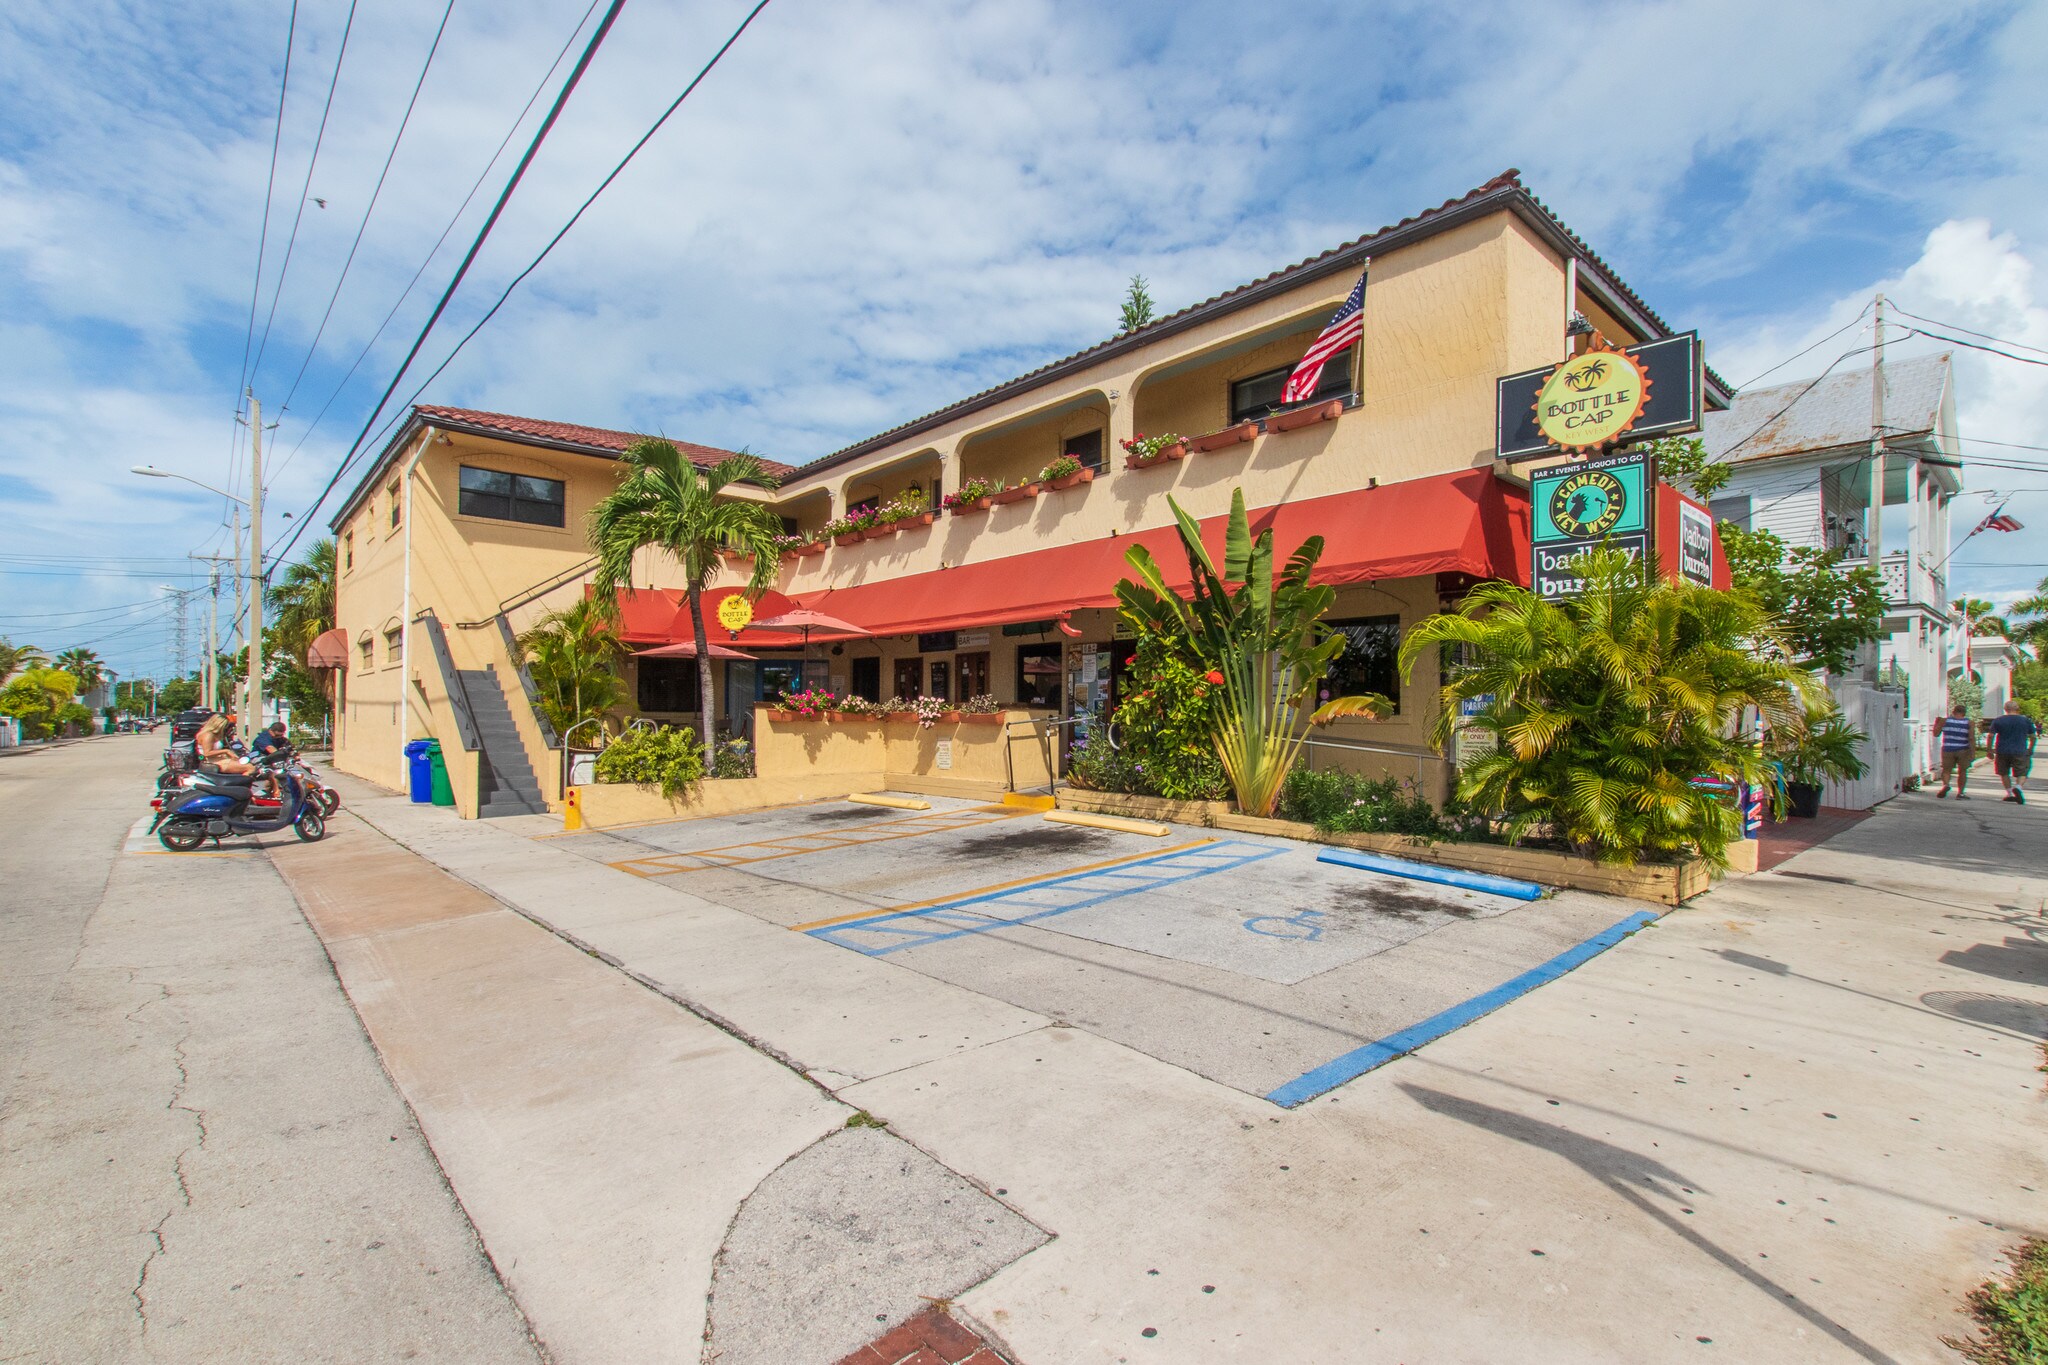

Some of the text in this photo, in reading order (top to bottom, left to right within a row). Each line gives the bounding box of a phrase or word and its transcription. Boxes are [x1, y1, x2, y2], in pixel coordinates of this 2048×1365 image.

[1547, 389, 1630, 418] BOTTLE
[1565, 409, 1613, 429] CAP
[1565, 425, 1610, 439] KEY WEST
[1555, 465, 1581, 475] EVENTS
[1588, 459, 1616, 469] LIQUOR
[1617, 456, 1628, 464] TO
[1558, 473, 1617, 499] COMEDY
[1555, 503, 1621, 534] KEY WEST
[1683, 520, 1710, 559] badboy
[1539, 546, 1640, 571] bady
